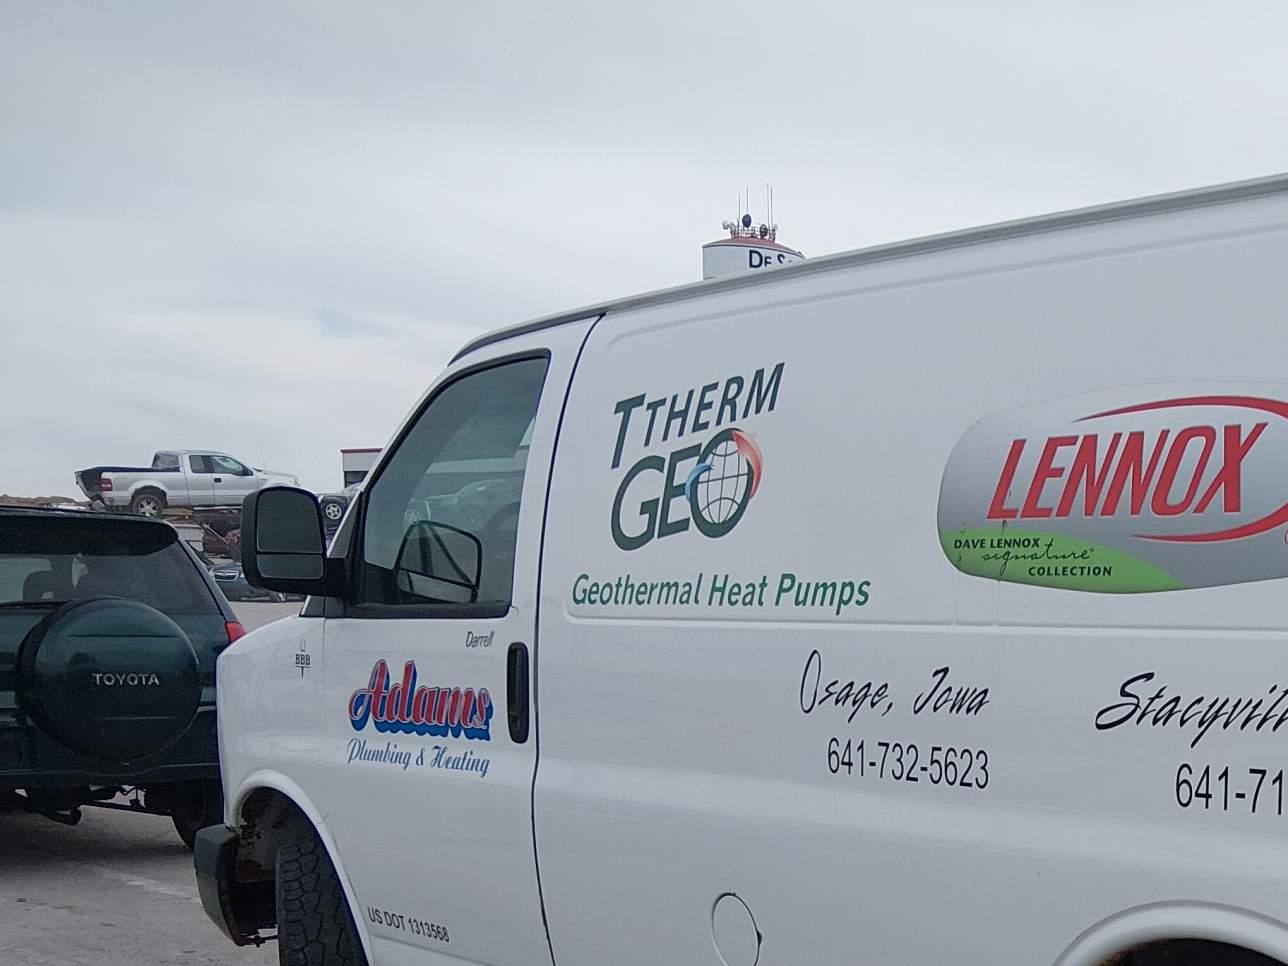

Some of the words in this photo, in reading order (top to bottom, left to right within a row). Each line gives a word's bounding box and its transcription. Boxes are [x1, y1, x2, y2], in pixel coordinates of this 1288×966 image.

[611, 427, 758, 551] GEO
[986, 422, 1269, 519] LENNOX
[954, 539, 986, 549] DAVE
[990, 538, 1040, 549] LENNOX
[1028, 566, 1112, 577] COLLECTION
[572, 573, 703, 606] Geothermal
[708, 574, 767, 607] Heat
[775, 573, 871, 616] Pumps
[465, 630, 495, 648] Darrell
[93, 673, 160, 686] TOYOTA
[295, 653, 311, 666] BBB
[349, 659, 493, 741] Adams
[799, 649, 893, 724] Osage,
[913, 667, 991, 718] Iowa
[348, 738, 411, 770] Plumbing
[415, 748, 425, 767] &
[431, 745, 490, 778] Heating
[827, 737, 989, 790] 641-732-5623
[367, 907, 383, 924] US
[384, 911, 406, 931] DOT
[408, 918, 450, 942] 1313568
